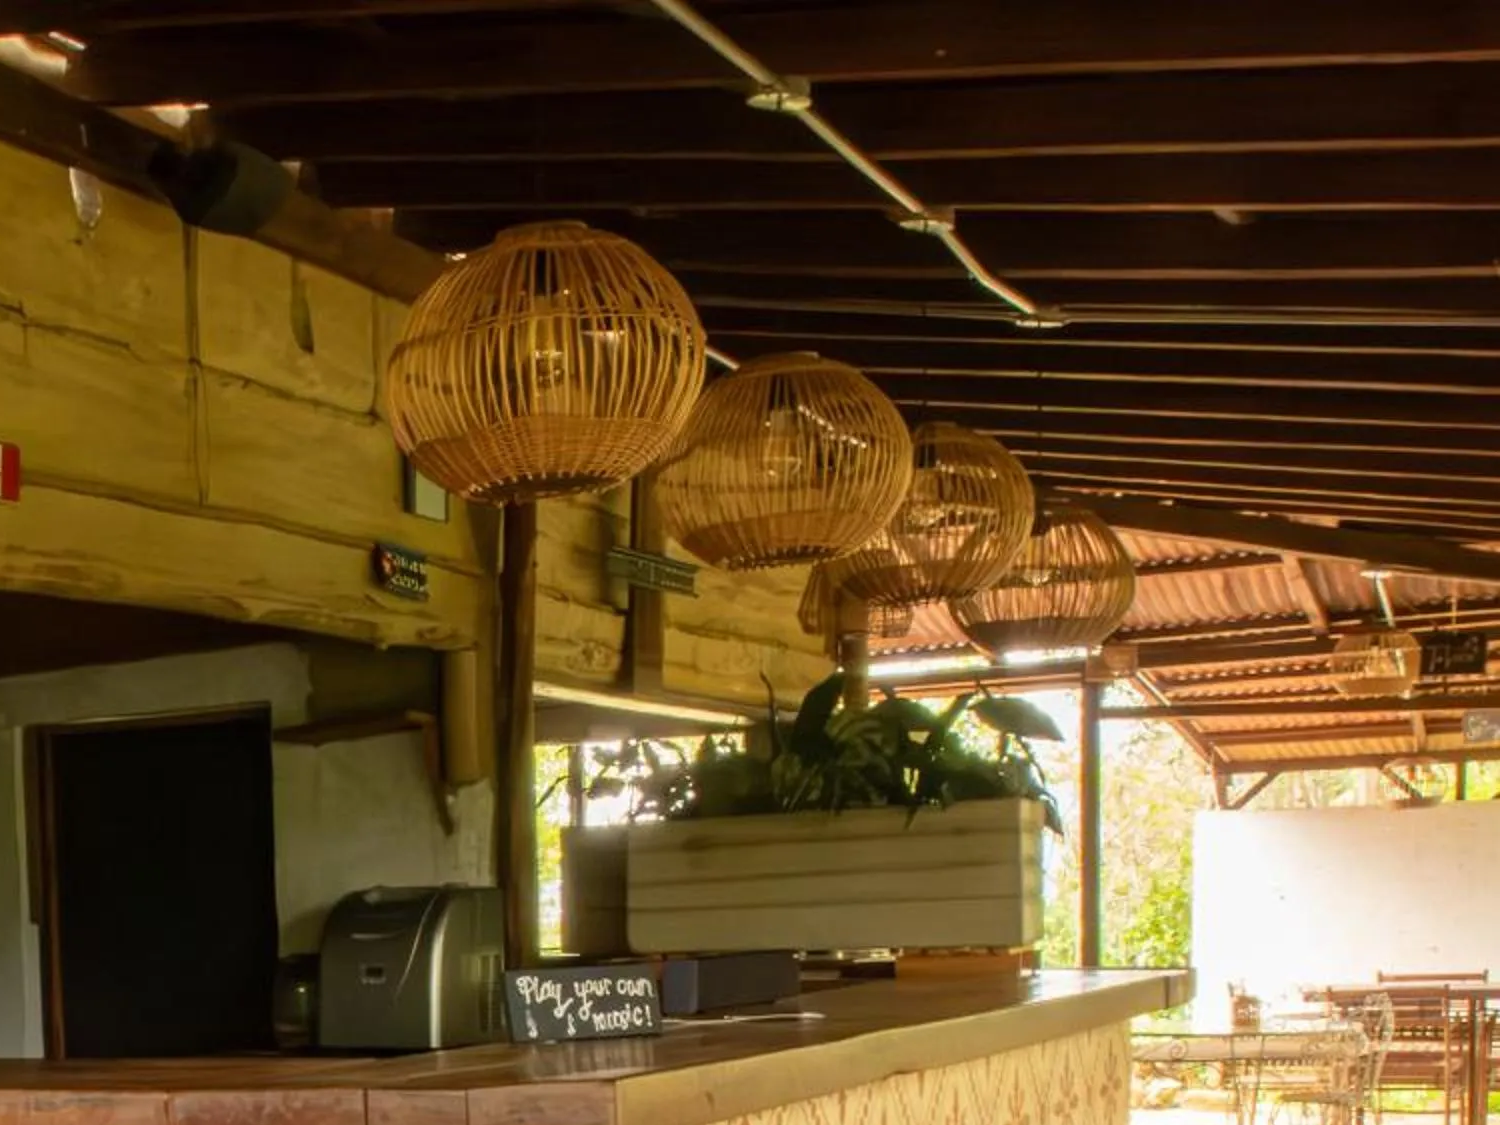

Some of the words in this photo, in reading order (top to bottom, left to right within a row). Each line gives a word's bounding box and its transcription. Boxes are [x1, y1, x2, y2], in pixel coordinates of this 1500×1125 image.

[515, 974, 573, 1019] Play
[573, 978, 612, 1021] your
[616, 977, 655, 998] own
[591, 1003, 654, 1033] music!
